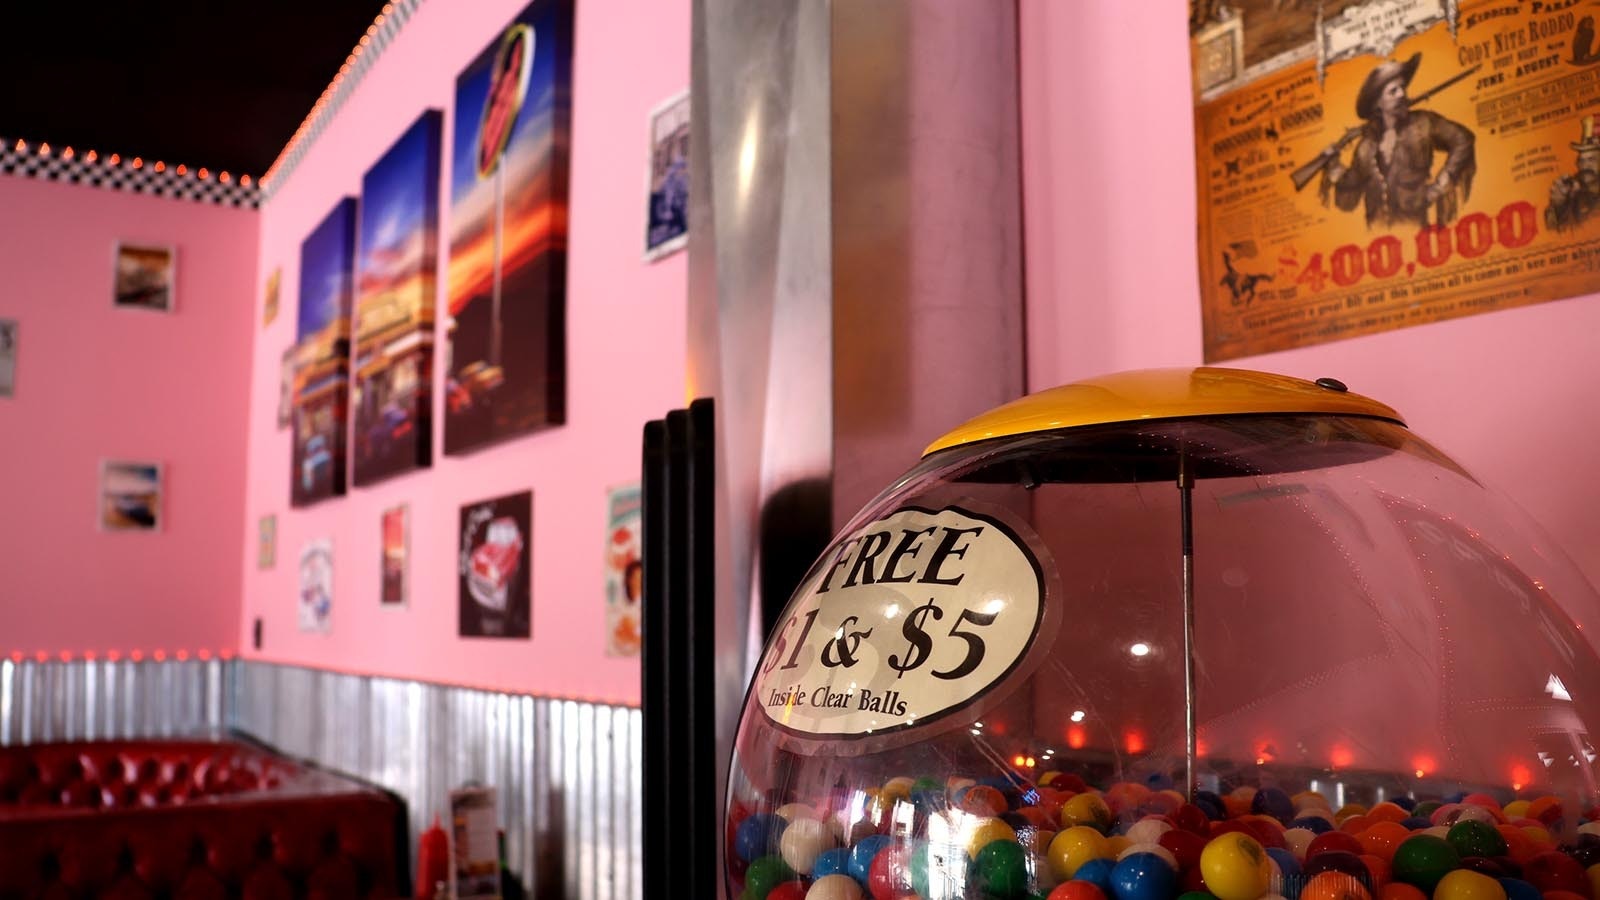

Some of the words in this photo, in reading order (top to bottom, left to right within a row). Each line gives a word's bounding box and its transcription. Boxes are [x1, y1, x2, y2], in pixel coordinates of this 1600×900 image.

[1458, 40, 1491, 66] CODY
[1494, 28, 1526, 54] NITE
[1528, 11, 1575, 42] RODEO
[1476, 73, 1504, 90] JUNE
[1516, 54, 1560, 77] AUGUST
[1527, 258, 1545, 270] see
[815, 526, 985, 595] FREE
[763, 608, 820, 679] $1
[820, 615, 873, 668] &
[887, 597, 999, 681] $5
[768, 684, 806, 708] Inside
[810, 686, 853, 709] Clear
[858, 688, 908, 717] Balls
